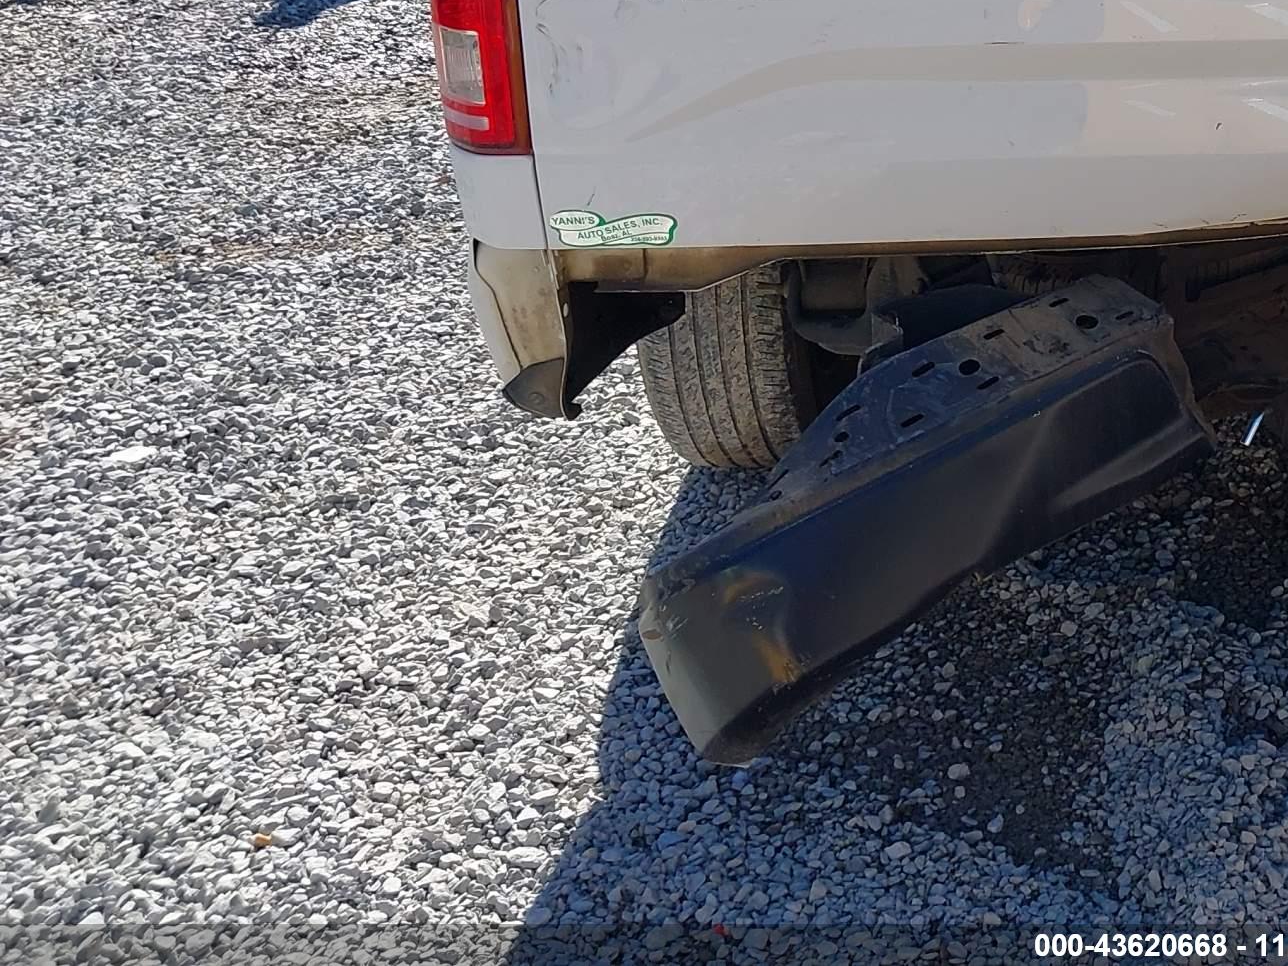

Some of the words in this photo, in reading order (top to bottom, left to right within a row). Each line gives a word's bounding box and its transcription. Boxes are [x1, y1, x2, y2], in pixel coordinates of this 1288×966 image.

[551, 216, 596, 226] YANNI'S
[578, 229, 604, 240] AUTO
[604, 220, 640, 235] SALES,
[641, 217, 663, 227] INC.
